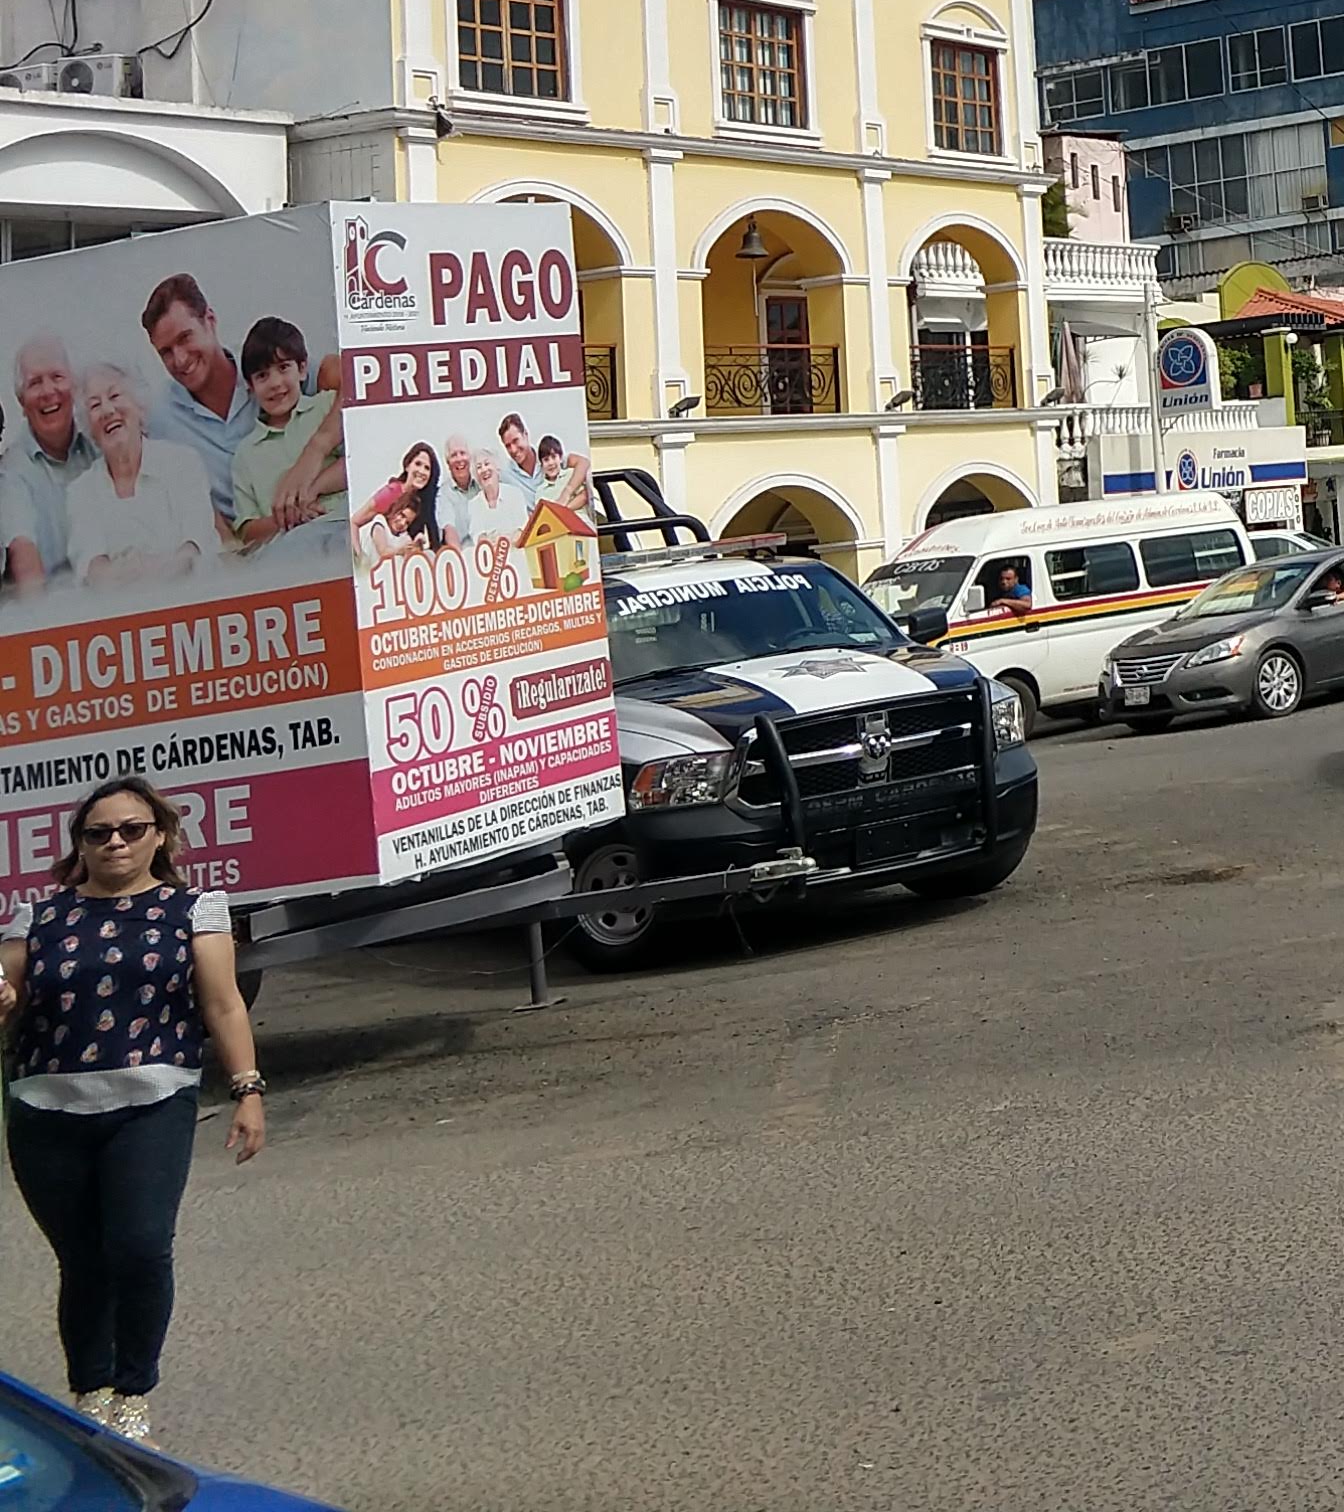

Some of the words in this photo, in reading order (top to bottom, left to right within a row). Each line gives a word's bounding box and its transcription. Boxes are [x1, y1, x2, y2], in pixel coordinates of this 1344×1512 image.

[428, 248, 573, 326] PAGO
[353, 342, 571, 400] PREDIAL
[1162, 392, 1209, 408] Unión
[1201, 464, 1245, 489] Unión
[1213, 447, 1245, 459] Farmacia
[1249, 489, 1294, 521] COPIAS
[487, 539, 508, 602] DESCUENTO
[31, 599, 326, 699] DICIEMBRE
[563, 615, 594, 635] MULTAS
[443, 653, 478, 671] GASTOS
[480, 650, 493, 662] DE
[27, 708, 40, 731] Y
[46, 694, 134, 728] GASTOS
[147, 687, 178, 713] DE
[191, 661, 329, 706] EJECUCIÓN)
[474, 677, 496, 739] SUBSIDIO
[117, 746, 146, 776] DE
[152, 726, 284, 771] CÁRDENAS,
[289, 717, 340, 750] TAB.
[391, 750, 485, 795] OCTUBRE
[499, 717, 611, 762] NOVIEMBRE
[394, 788, 442, 812] ADULTOS
[444, 776, 492, 797] MAYORES
[493, 763, 539, 785] (INAPAM)
[547, 741, 612, 769] CAPACIDADES
[392, 820, 466, 855] VENTANILLAS
[467, 814, 483, 831] DE
[484, 810, 498, 825] LA
[500, 790, 556, 821] DIRECCIÓN
[558, 788, 572, 804] DE
[574, 772, 621, 800] FINANZAS
[479, 776, 539, 803] DIFERENTES
[414, 853, 427, 869] H.
[429, 828, 510, 865] AYUNTAMIENTO
[511, 822, 527, 837] DE
[587, 797, 609, 815] TAB.
